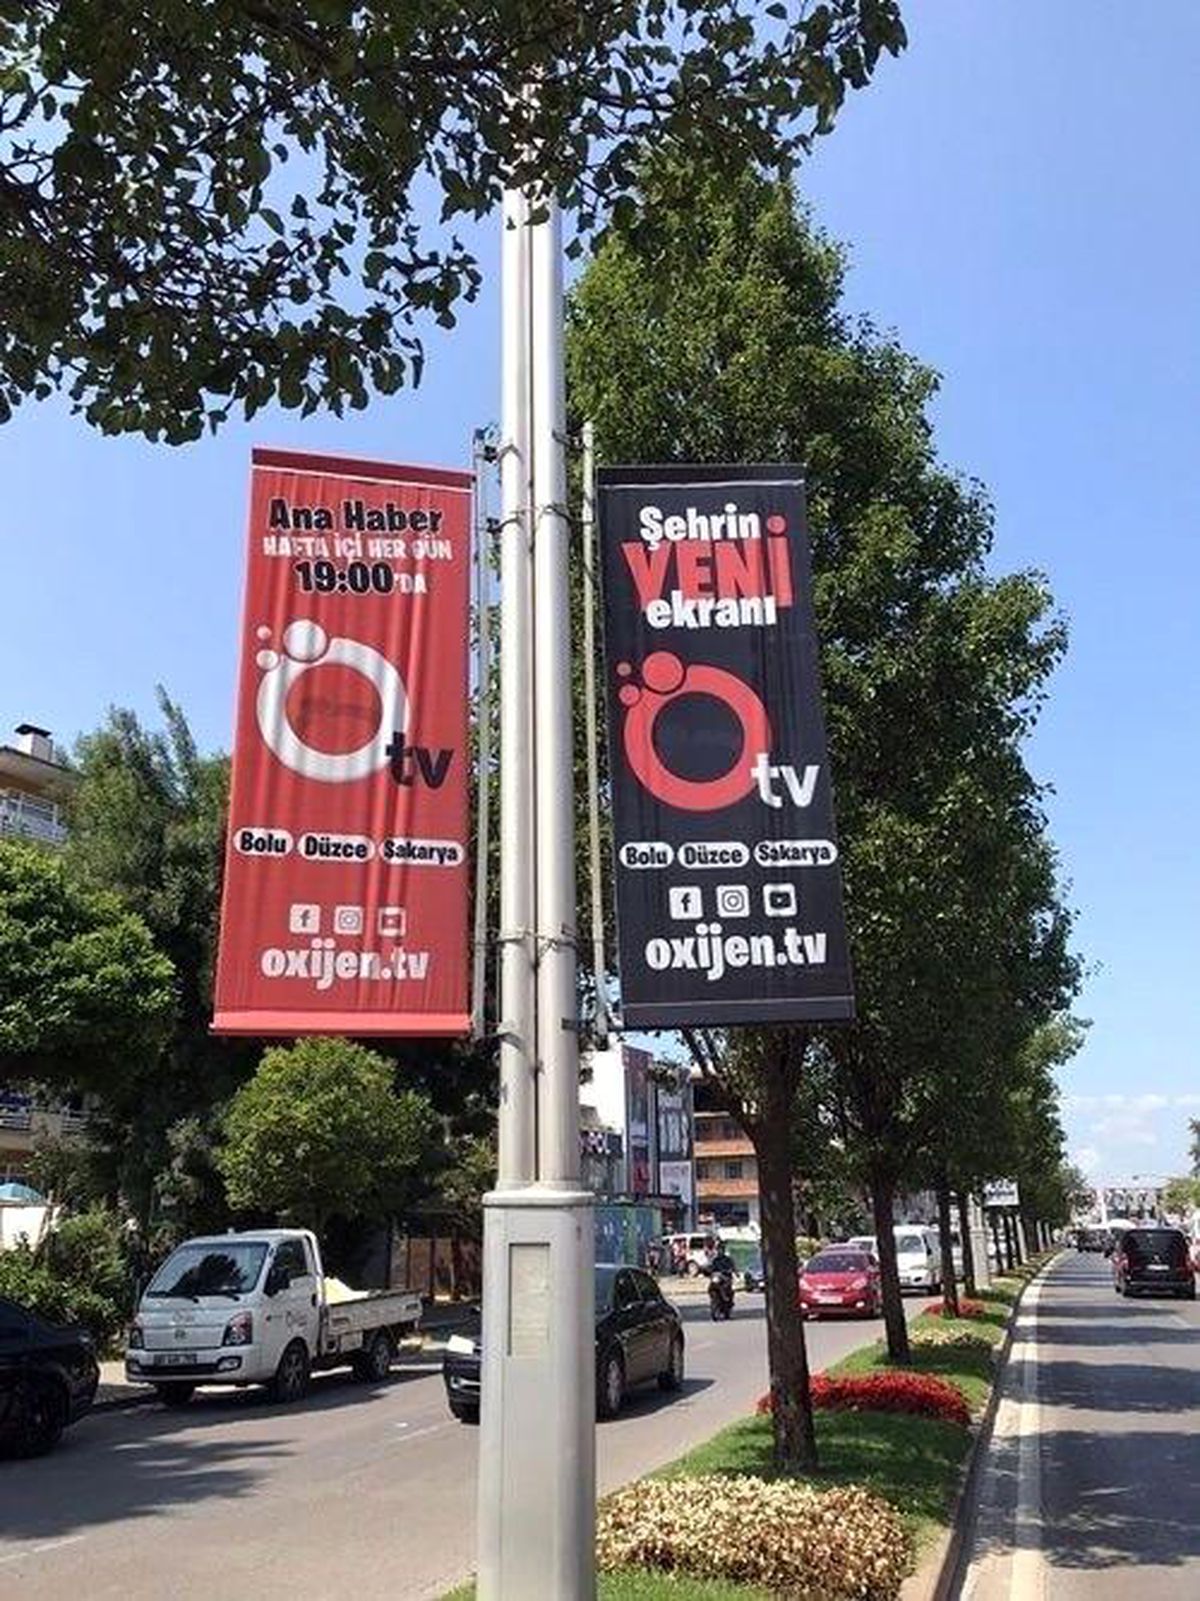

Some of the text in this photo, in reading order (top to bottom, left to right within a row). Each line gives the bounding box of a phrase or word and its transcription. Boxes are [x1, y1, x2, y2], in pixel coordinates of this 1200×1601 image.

[268, 498, 443, 533] Ana Haber
[639, 502, 761, 551] Şehrin
[368, 538, 407, 559] HER
[646, 590, 777, 629] ekranı
[239, 831, 459, 865] Bolu Düzce Sakarya
[625, 843, 831, 866] Bolu Düzce Sakarya
[261, 938, 429, 989] oxijen.tv
[645, 923, 827, 981] oxijen.tv
